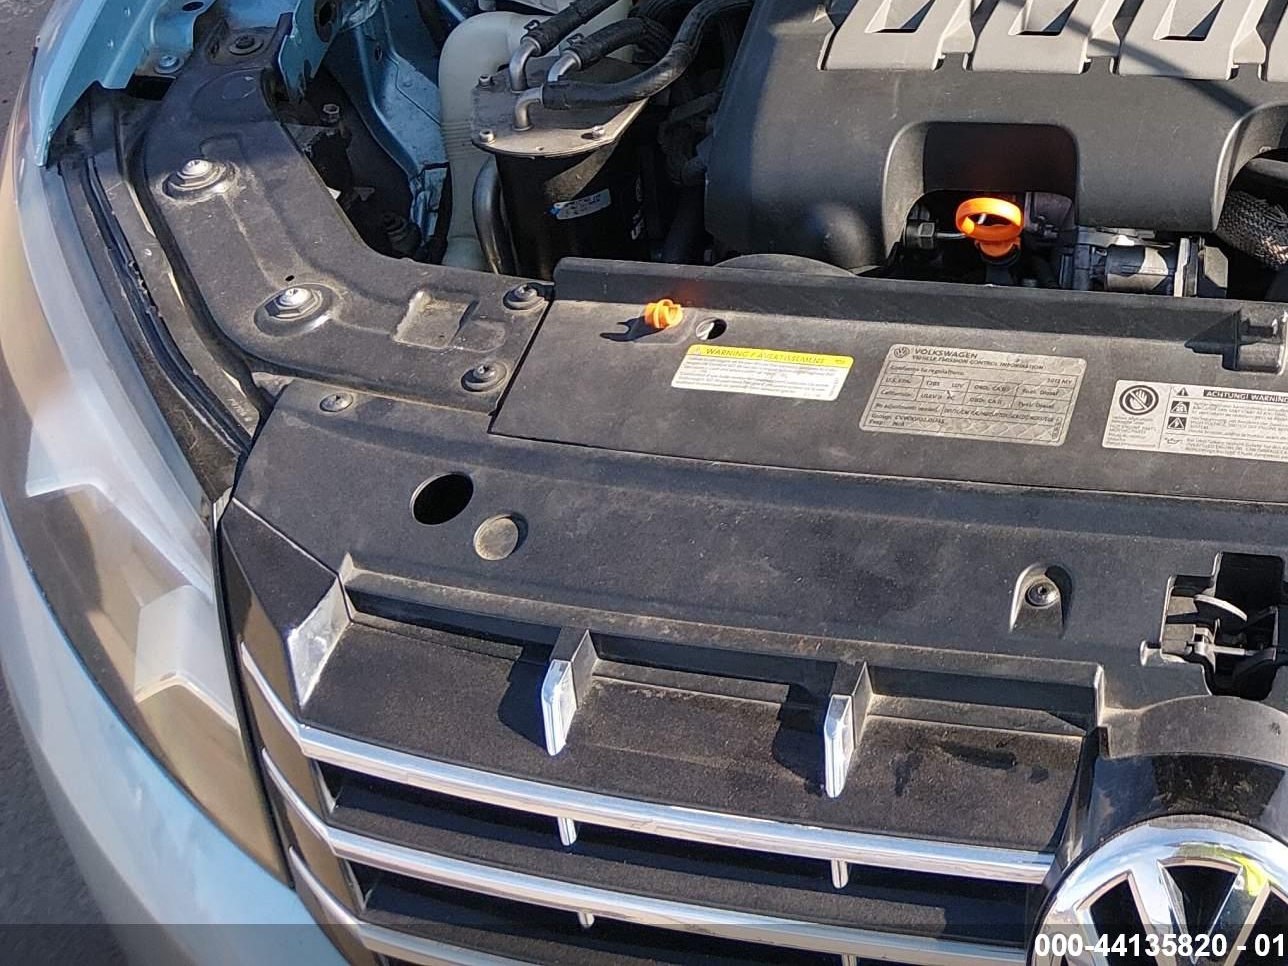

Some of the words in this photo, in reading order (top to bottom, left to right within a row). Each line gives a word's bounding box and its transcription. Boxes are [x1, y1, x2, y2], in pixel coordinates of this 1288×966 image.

[706, 348, 747, 356] WARNING
[914, 348, 977, 359] VOLKSWAGEN
[1205, 390, 1249, 401] ACHTUNG!
